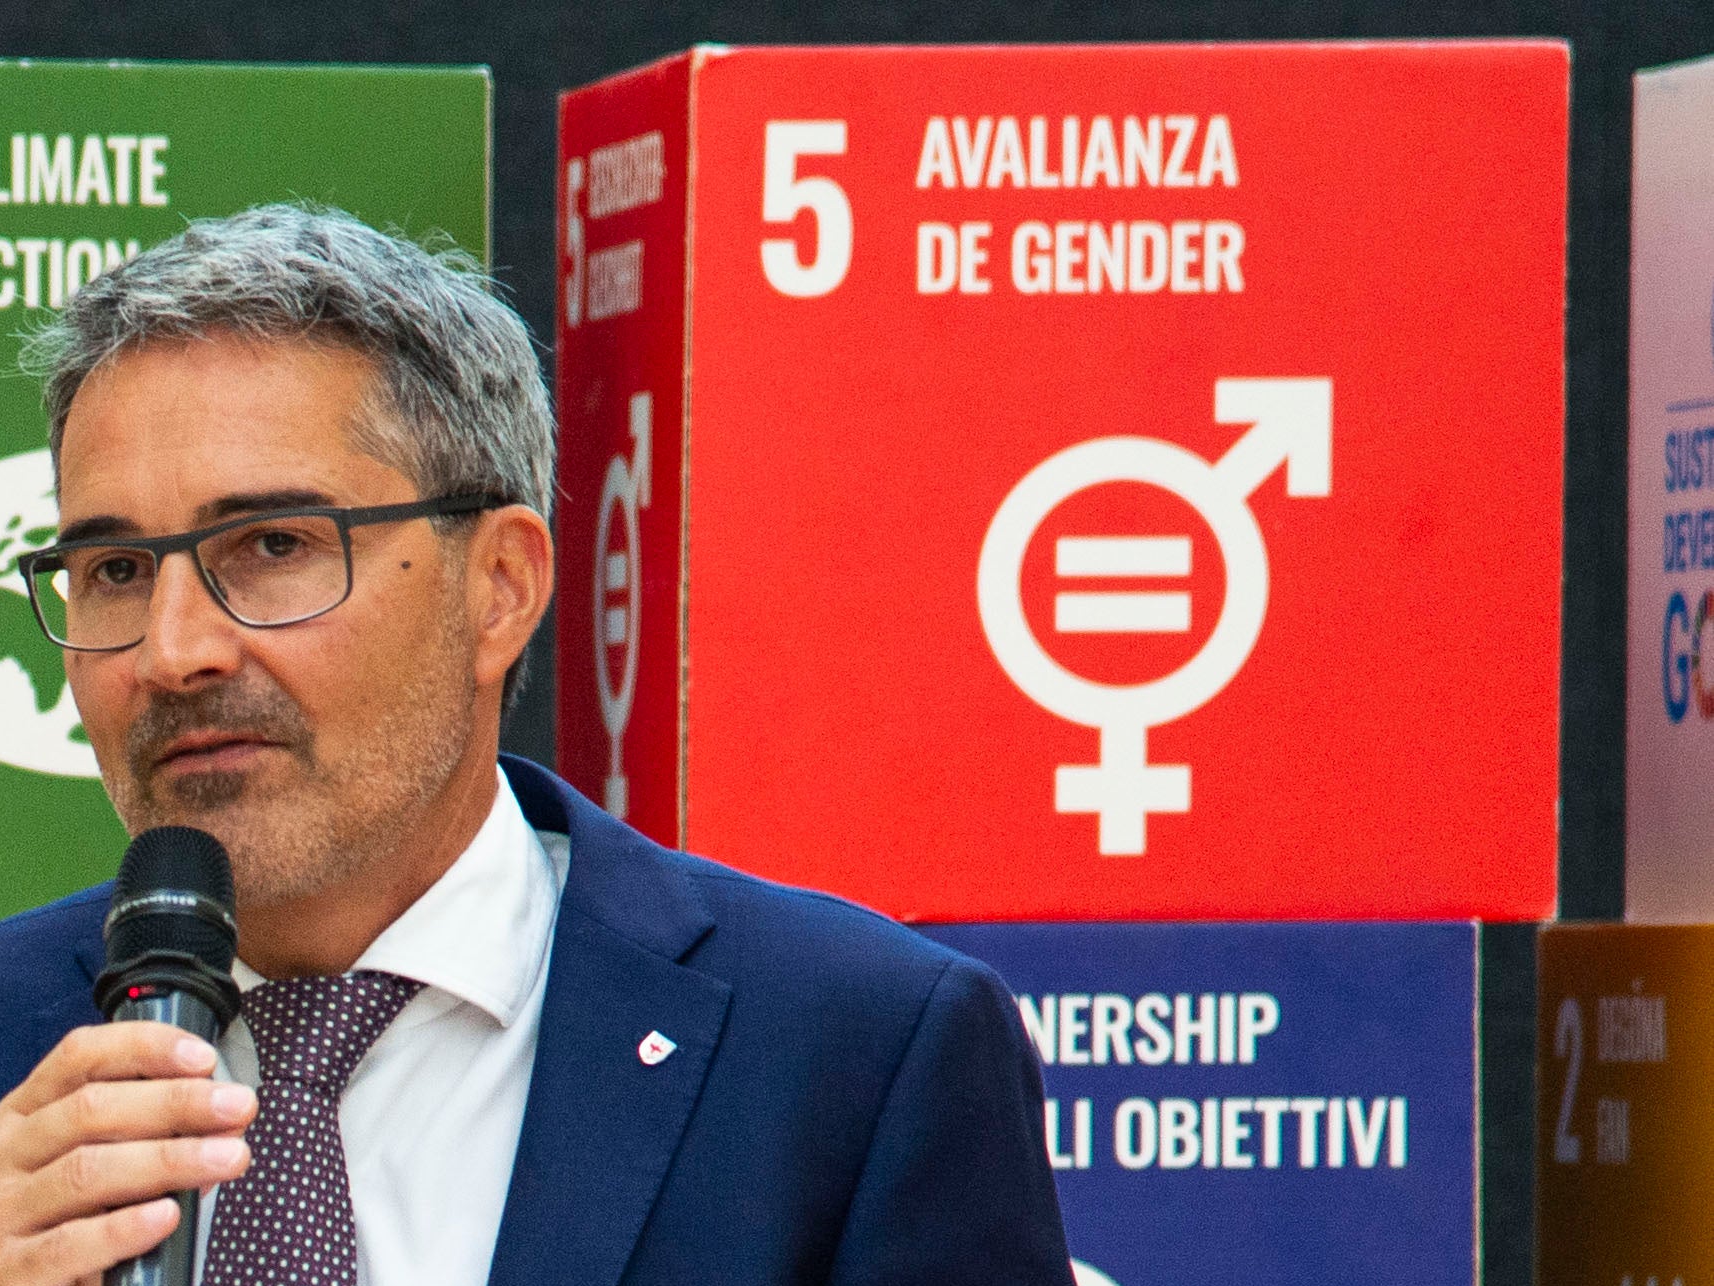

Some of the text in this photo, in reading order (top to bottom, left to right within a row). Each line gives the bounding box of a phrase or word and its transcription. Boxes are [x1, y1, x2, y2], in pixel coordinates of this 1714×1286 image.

[916, 116, 1239, 189] AVALIANZA
[760, 120, 853, 298] 5
[917, 222, 1245, 294] DE GENDER
[1555, 999, 1583, 1163] 2
[1114, 1097, 1408, 1170] OBIETTIVI
